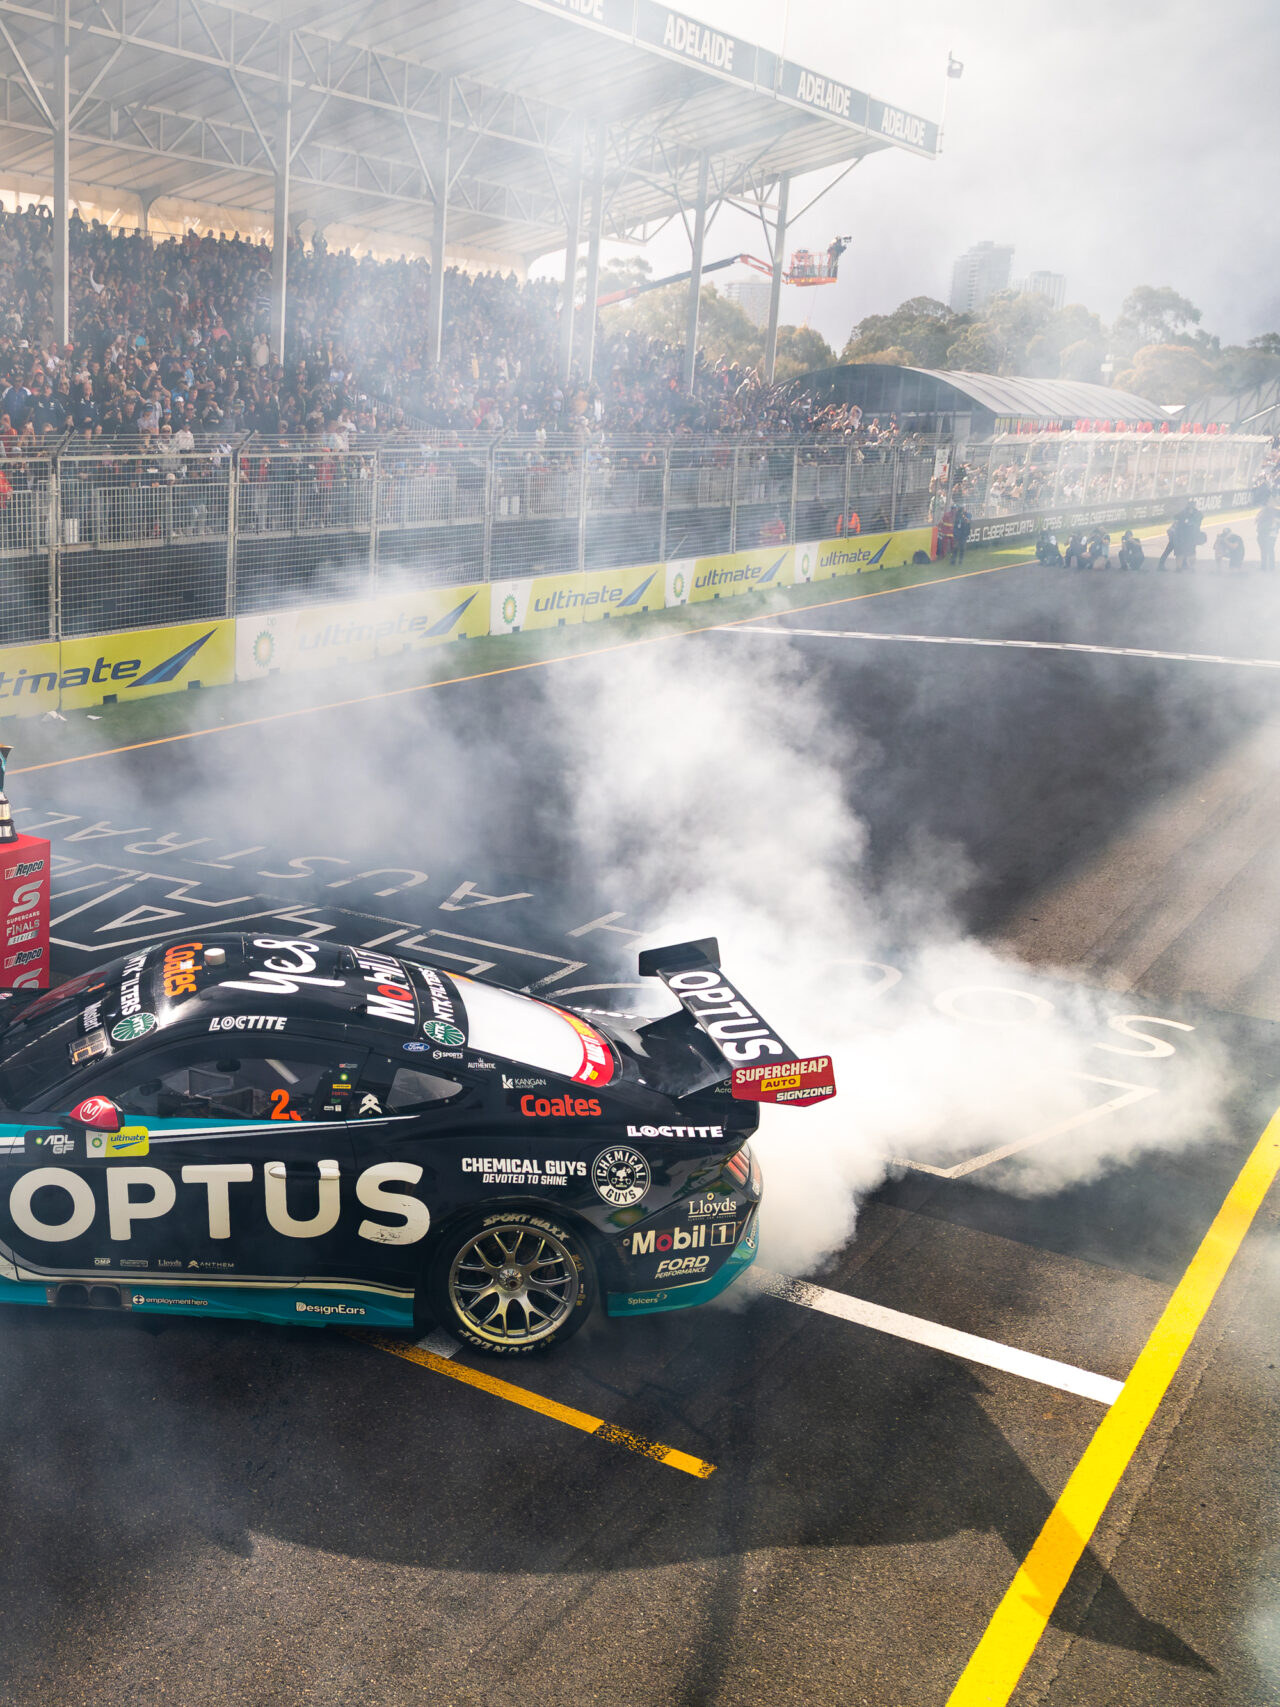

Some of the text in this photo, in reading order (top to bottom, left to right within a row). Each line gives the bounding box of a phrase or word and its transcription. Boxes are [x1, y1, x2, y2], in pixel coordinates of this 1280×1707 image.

[663, 13, 735, 71] ADELAIDE
[796, 71, 852, 117] ADELAIDE
[880, 107, 926, 146] ADELAIDE
[820, 548, 871, 567] ultimate
[695, 564, 762, 589] ultimate
[534, 584, 623, 613] ultimate
[297, 612, 429, 652] ultimate
[15, 860, 44, 877] Repco
[6, 911, 40, 925] SUPERCARS
[6, 919, 40, 937] FINALS
[12, 932, 34, 944] SERIES
[15, 947, 43, 966] Repco
[163, 942, 203, 998] Coates
[357, 959, 416, 1025] Mobil
[431, 997, 455, 1023] NTK
[668, 970, 784, 1061] OPTUS
[208, 1015, 288, 1031] LOCTITE
[735, 1058, 829, 1084] SUPERCHEAP
[515, 1078, 547, 1086] KANGAN
[764, 1077, 797, 1088] AUTO
[776, 1085, 834, 1102] SIGNZONE
[520, 1094, 602, 1117] Coates
[43, 1134, 75, 1145] ADL
[110, 1133, 146, 1142] ultimate
[626, 1124, 724, 1139] LOCTITE
[53, 1144, 75, 1154] GF
[461, 1157, 587, 1177] CHEMICAL GUYS
[596, 1150, 646, 1177] CHEMICAL
[482, 1173, 568, 1186] DEVOTED TO SHINE
[9, 1159, 431, 1246] OPTUS
[606, 1188, 637, 1203] GUYS
[688, 1197, 737, 1217] Lloyds
[483, 1213, 570, 1242] SPORT MAXX
[632, 1224, 706, 1255] Mobil
[654, 1266, 708, 1280] PERFORMANCE
[657, 1255, 710, 1273] FORD
[295, 1301, 366, 1315] DesignEars
[627, 1296, 658, 1306] Spicers
